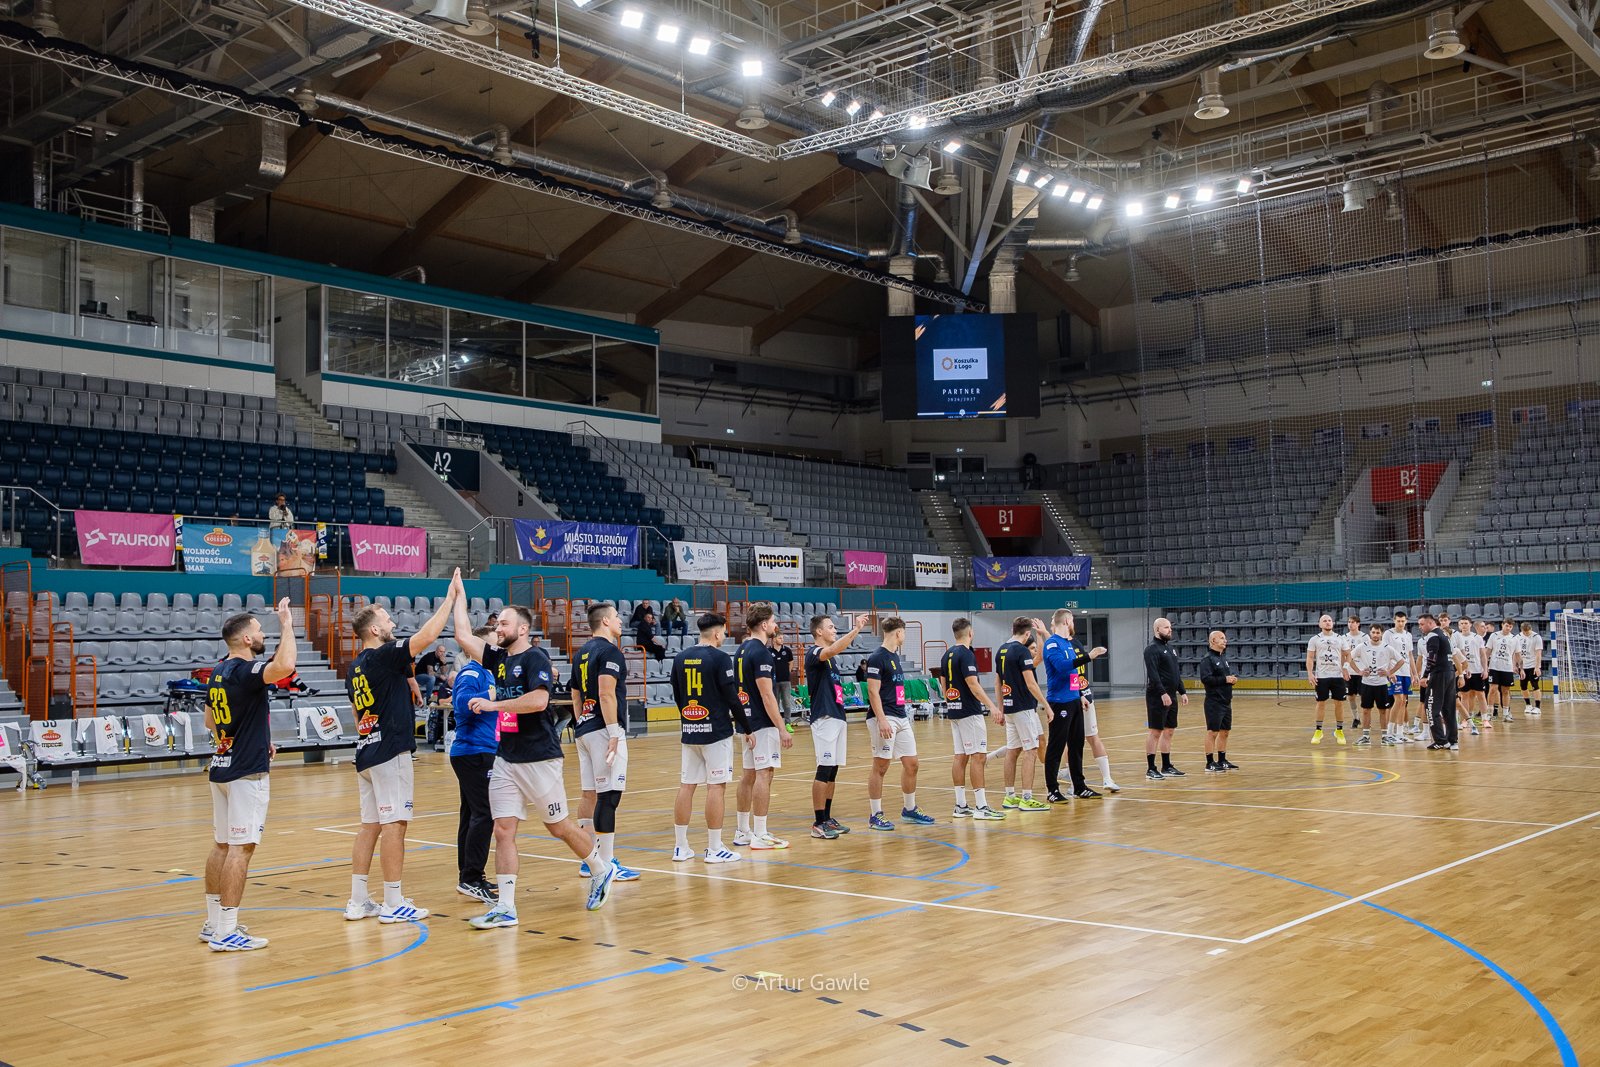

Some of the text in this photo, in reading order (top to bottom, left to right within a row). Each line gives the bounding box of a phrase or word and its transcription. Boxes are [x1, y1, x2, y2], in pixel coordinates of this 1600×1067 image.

[433, 451, 452, 472] A2
[1400, 470, 1418, 487] B2
[999, 509, 1014, 525] B1
[109, 532, 170, 548] TAURON
[564, 531, 628, 546] MIASTO TARNÓW
[184, 547, 220, 556] WOLNOŚĆ
[373, 543, 420, 557] TAURON
[564, 544, 627, 557] WSPIERA SPORT
[697, 548, 716, 557] EMES
[184, 556, 232, 565] WYOBRAŹNIA
[758, 553, 791, 569] mpec
[1018, 562, 1081, 573] MIASTO TARNÓW
[858, 563, 883, 574] TAURON
[915, 561, 943, 576] mpec
[1018, 572, 1080, 582] WSPIERA SPORT
[1327, 644, 1332, 653] 4
[1371, 656, 1377, 665] 5
[684, 667, 703, 697] 14
[352, 674, 375, 711] 23
[209, 687, 232, 725] 33
[683, 707, 706, 716] ROLESKI
[547, 801, 562, 817] 34
